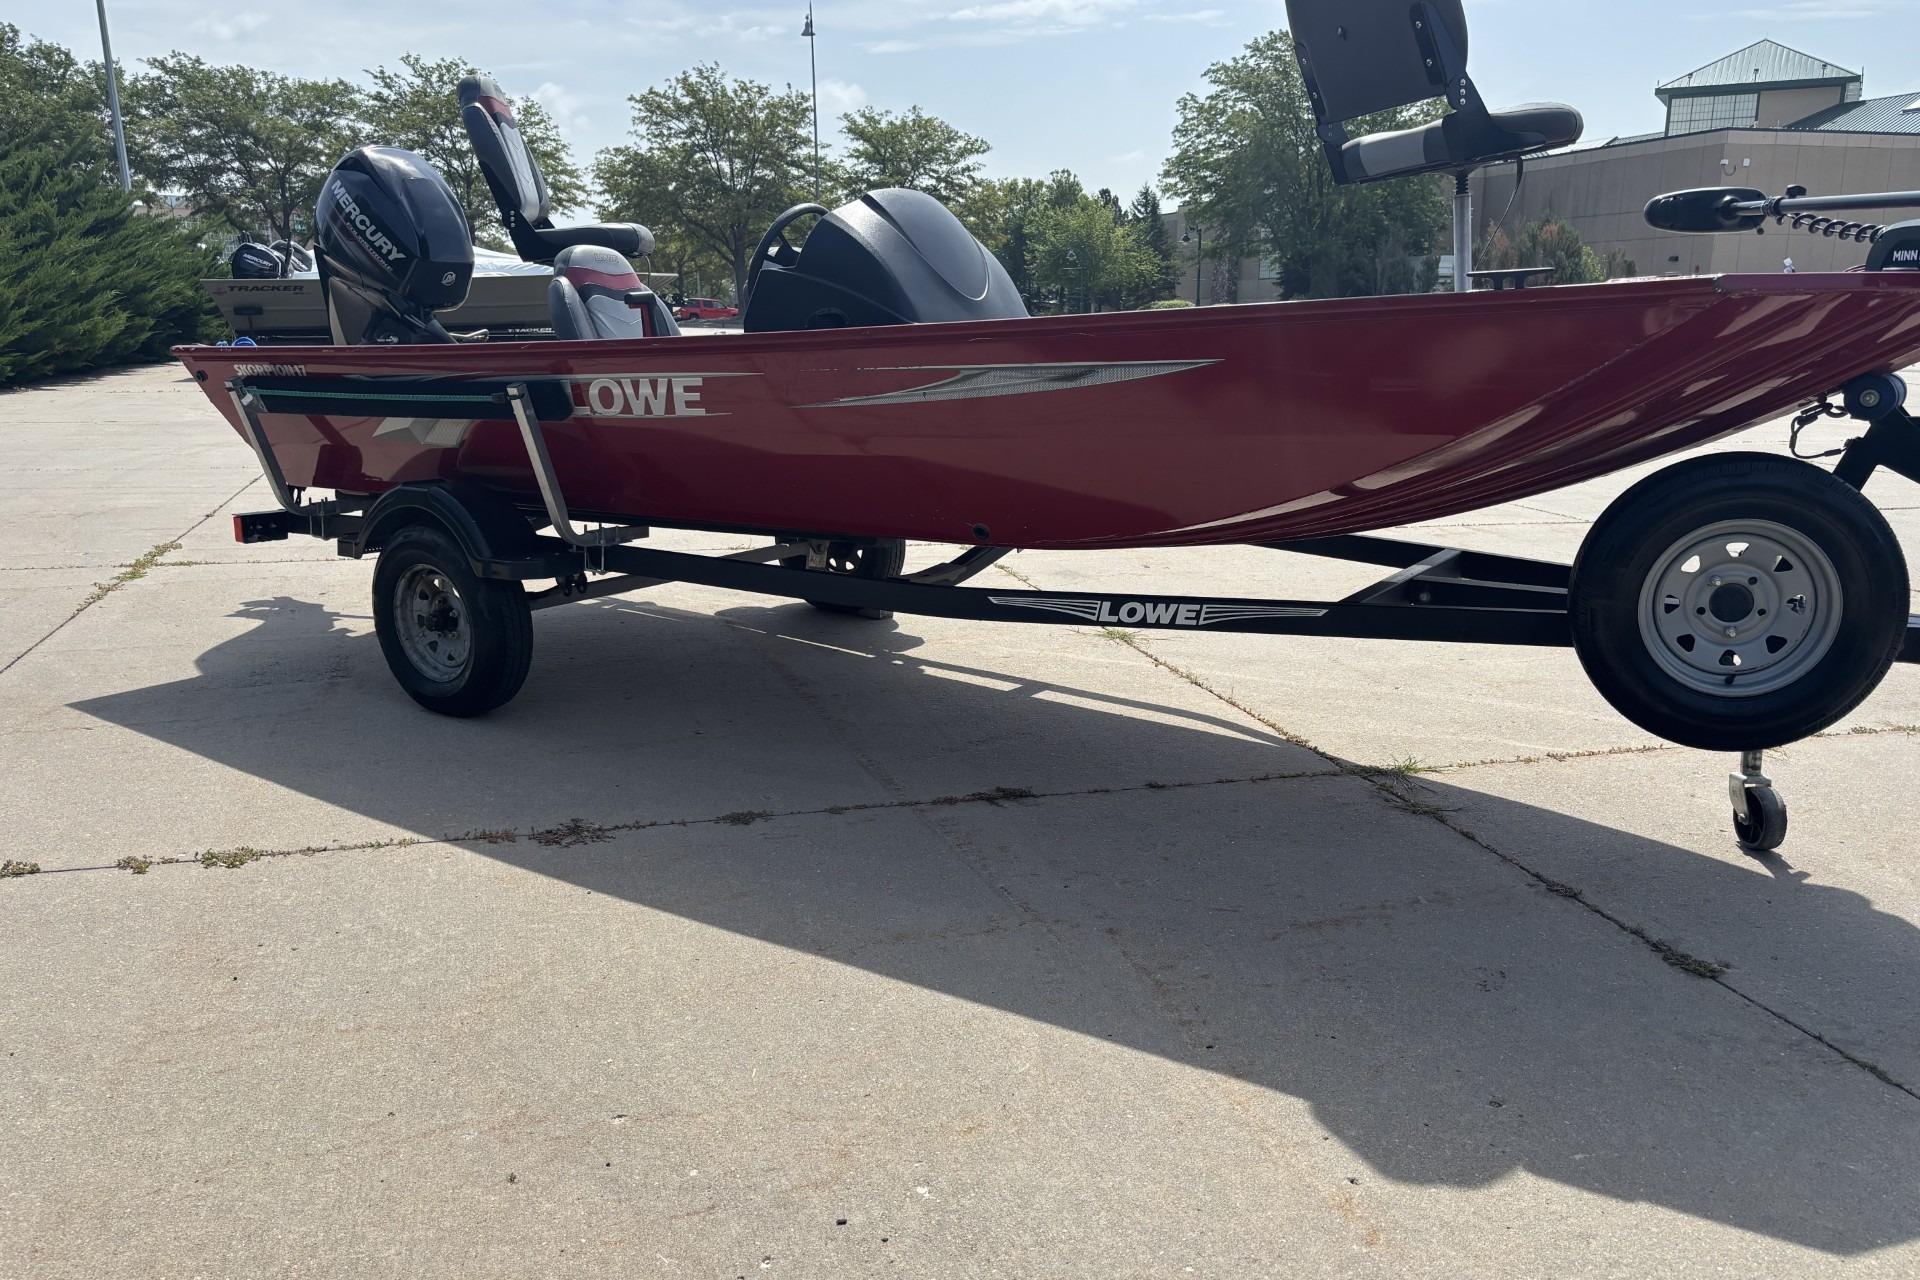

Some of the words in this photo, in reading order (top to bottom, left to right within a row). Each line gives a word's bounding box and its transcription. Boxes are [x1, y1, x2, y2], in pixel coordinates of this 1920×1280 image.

[331, 179, 407, 261] MERCURY
[243, 252, 273, 268] MERCURY
[1892, 249, 1919, 262] MINN
[1099, 601, 1200, 625] LOWE
